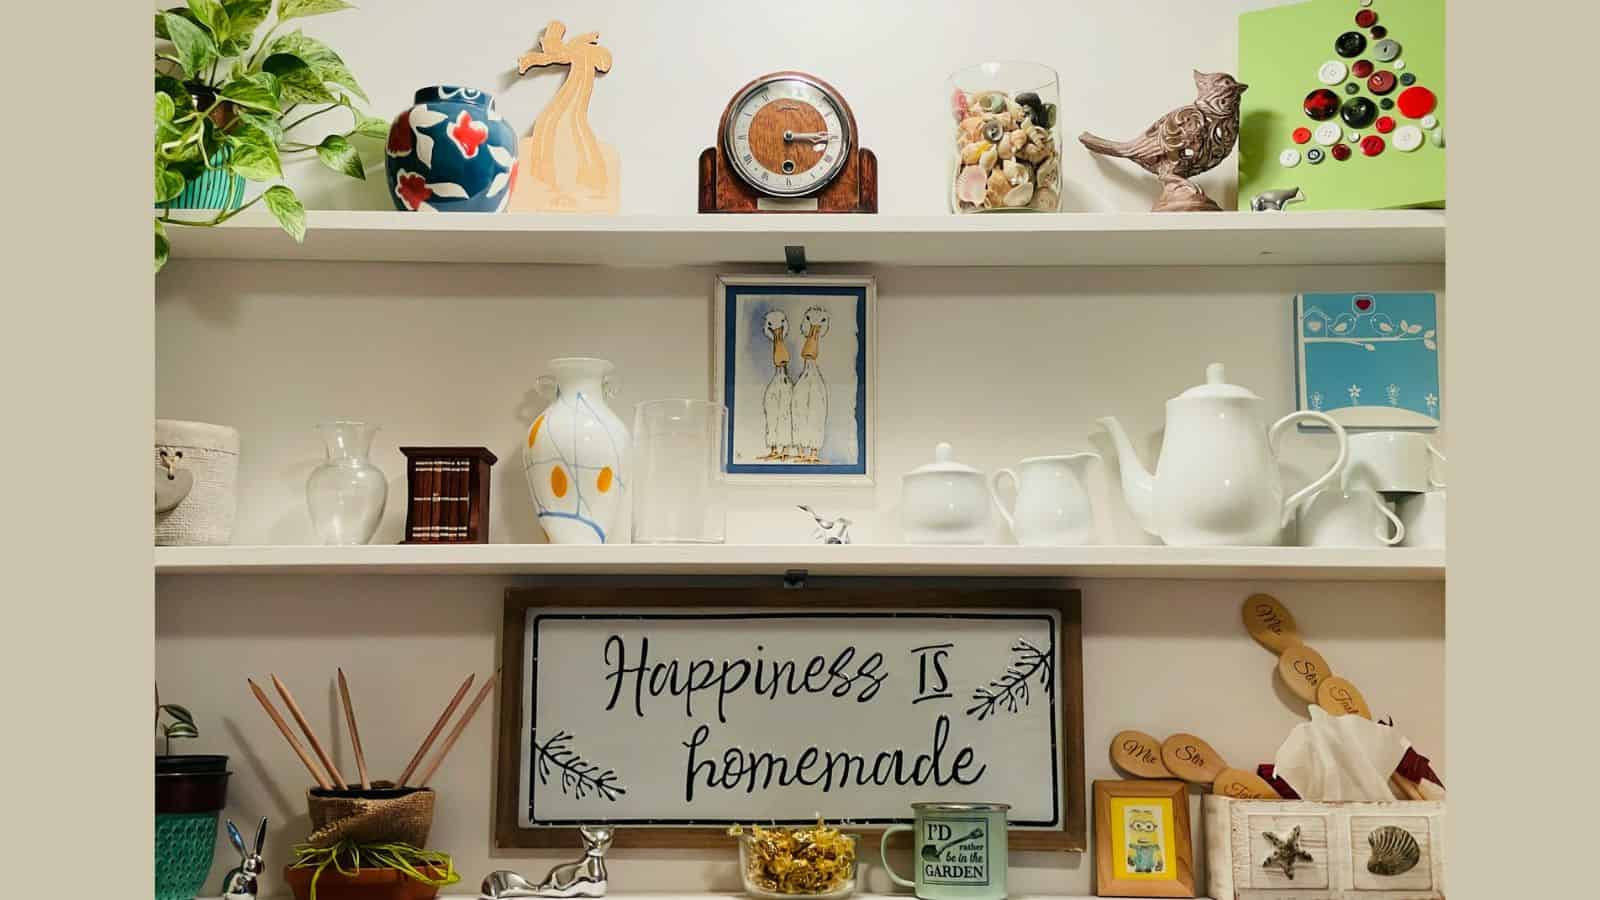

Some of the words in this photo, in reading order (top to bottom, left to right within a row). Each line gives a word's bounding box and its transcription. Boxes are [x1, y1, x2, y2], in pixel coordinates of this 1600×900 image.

[604, 634, 889, 723] Happiness
[910, 643, 955, 704] IS
[682, 714, 987, 802] homemade
[927, 823, 952, 841] I'D
[959, 842, 984, 851] rather
[945, 851, 957, 863] be
[958, 854, 967, 863] in
[969, 851, 984, 863] the
[925, 864, 984, 879] GARDEN
